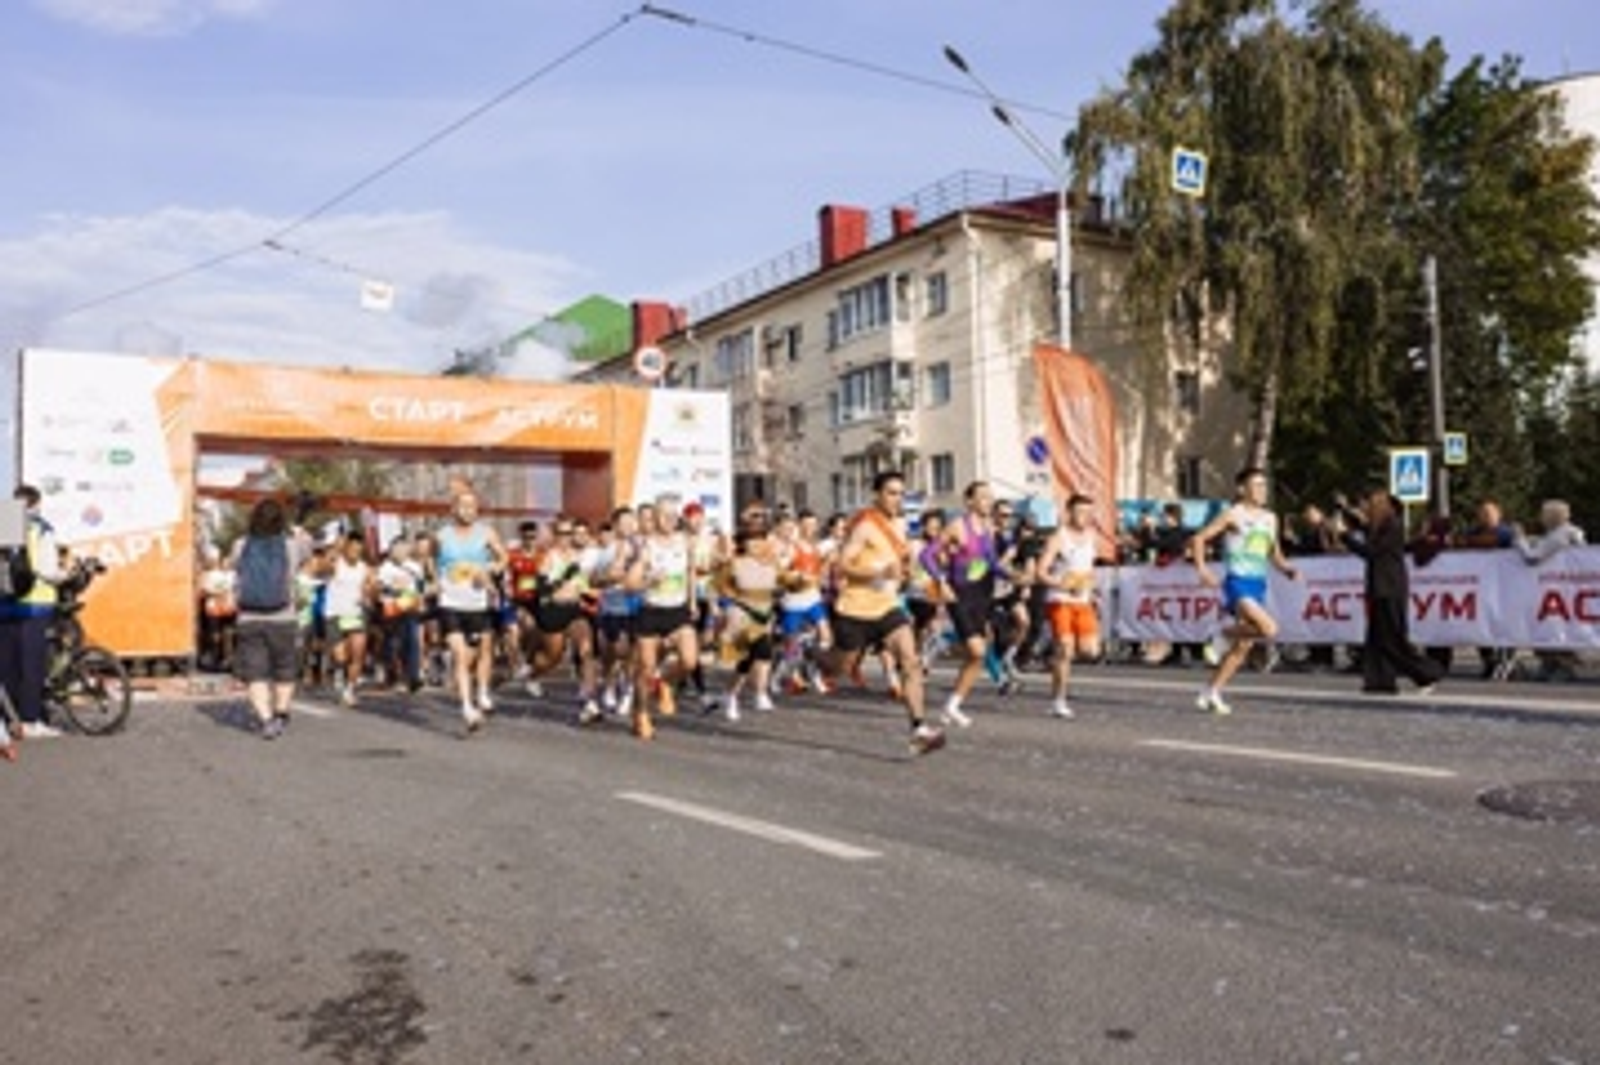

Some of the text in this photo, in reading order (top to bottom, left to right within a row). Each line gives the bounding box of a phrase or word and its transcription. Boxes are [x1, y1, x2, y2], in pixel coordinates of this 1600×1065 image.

[369, 398, 464, 421] СТАРТ
[1136, 596, 1227, 621] АСТР
[1302, 592, 1477, 621] АСТУМ
